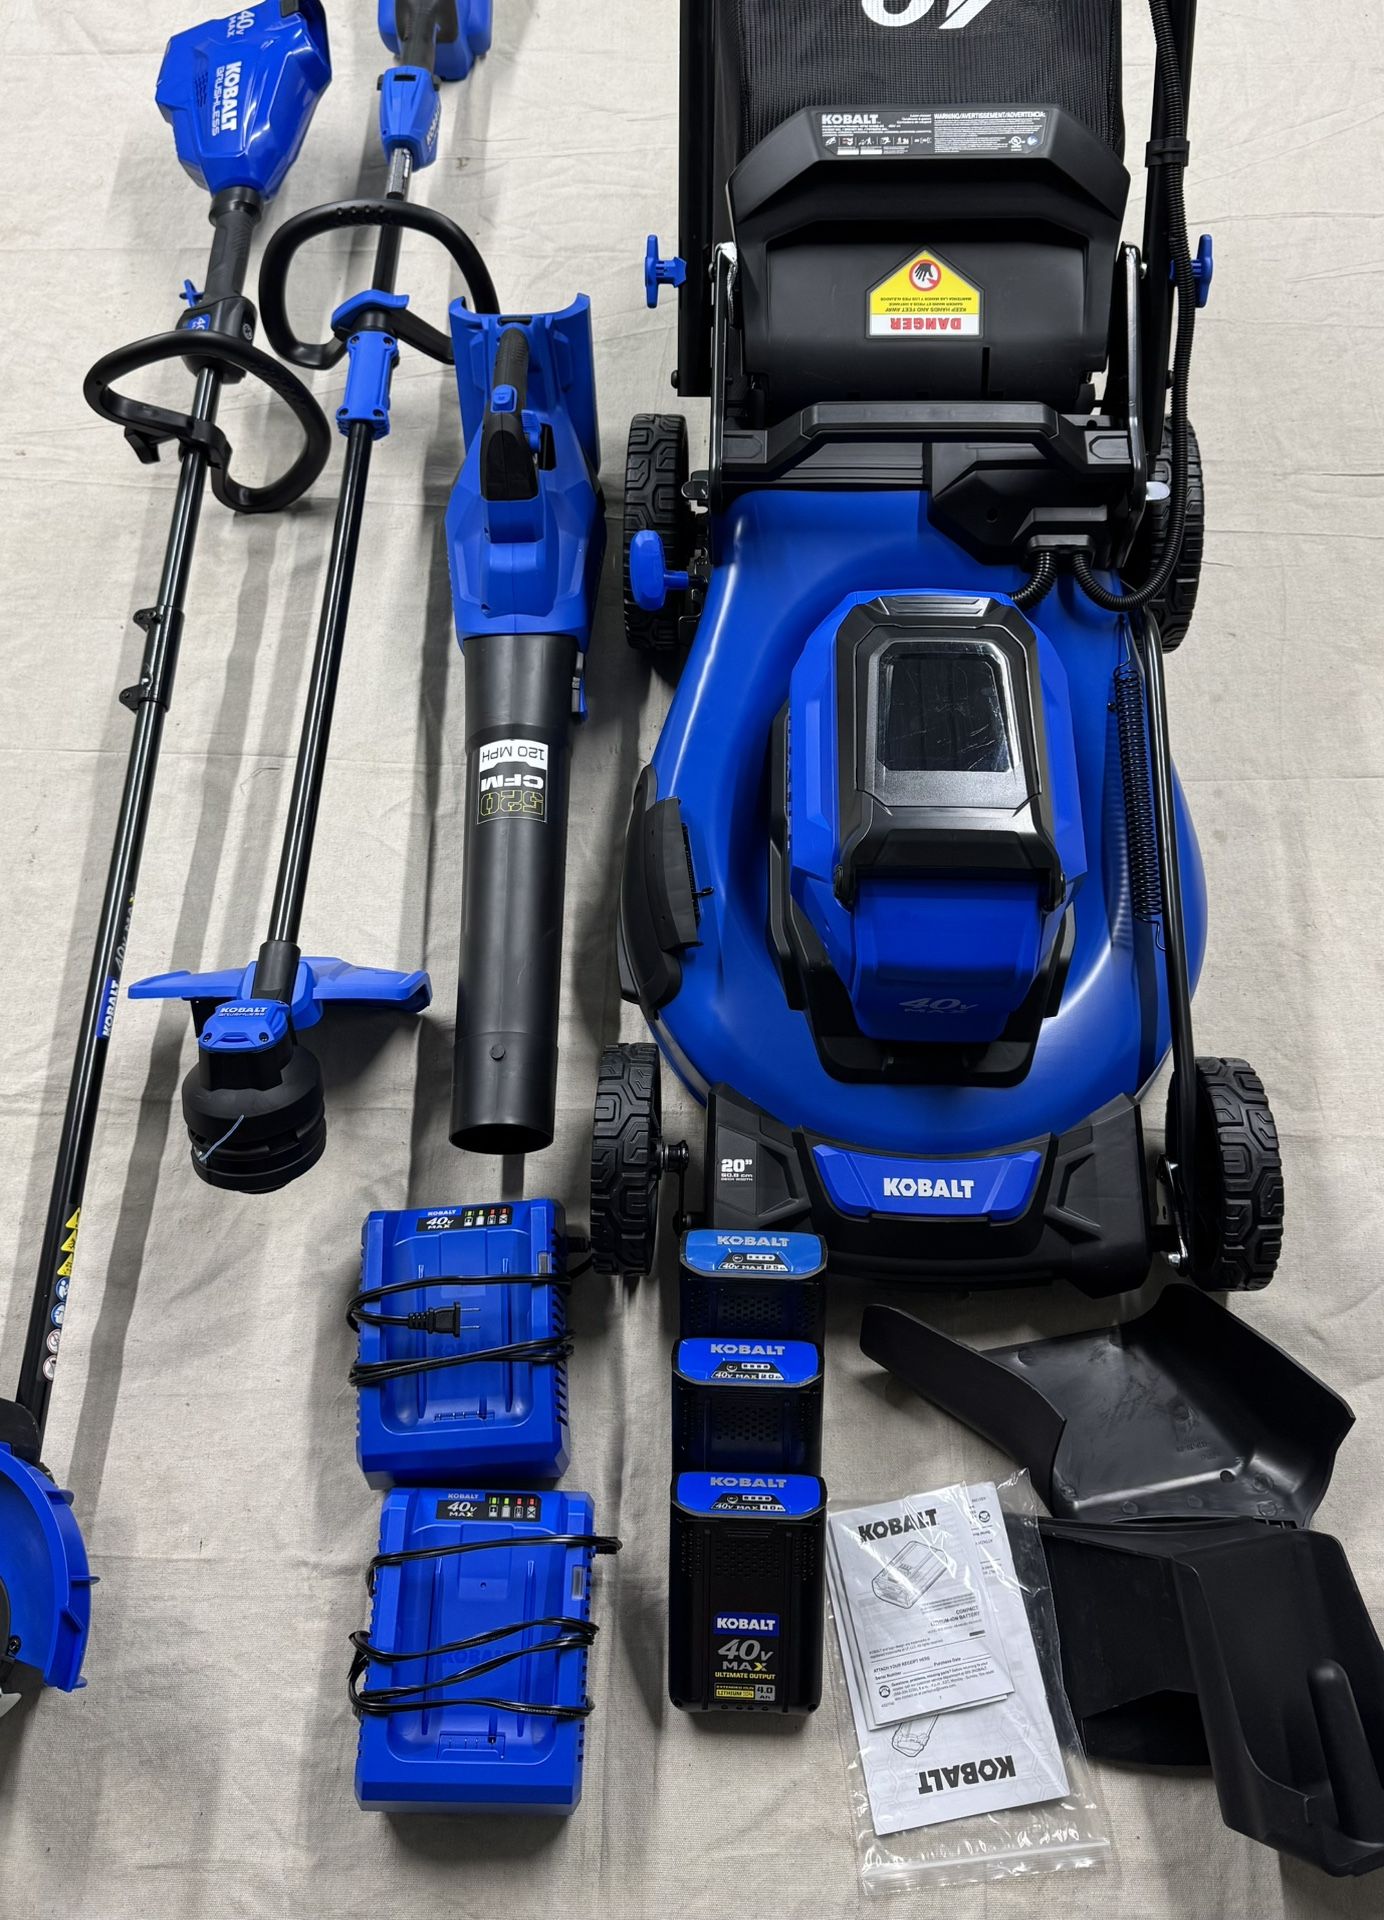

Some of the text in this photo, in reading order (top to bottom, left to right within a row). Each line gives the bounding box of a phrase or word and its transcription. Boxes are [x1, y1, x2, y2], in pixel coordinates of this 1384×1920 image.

[212, 66, 225, 136] BRUSHLESS
[221, 61, 242, 130] KOBALT
[822, 114, 878, 124] KOBALT
[890, 318, 961, 330] DANGER
[482, 746, 545, 763] 120 MPH
[481, 773, 544, 792] CFM
[481, 790, 544, 816] 520
[884, 1178, 974, 1198] KOBALT
[717, 1235, 790, 1247] KOBALT
[711, 1344, 785, 1355] KOBALT
[710, 1477, 787, 1488] KOBALT
[858, 1508, 937, 1542] KOBALT
[955, 1606, 978, 1614] COMPACT
[716, 1618, 775, 1630] KOBALT
[722, 1661, 767, 1672] MAX
[757, 1686, 773, 1694] 4.0
[918, 1755, 1016, 1795] KOBALT
